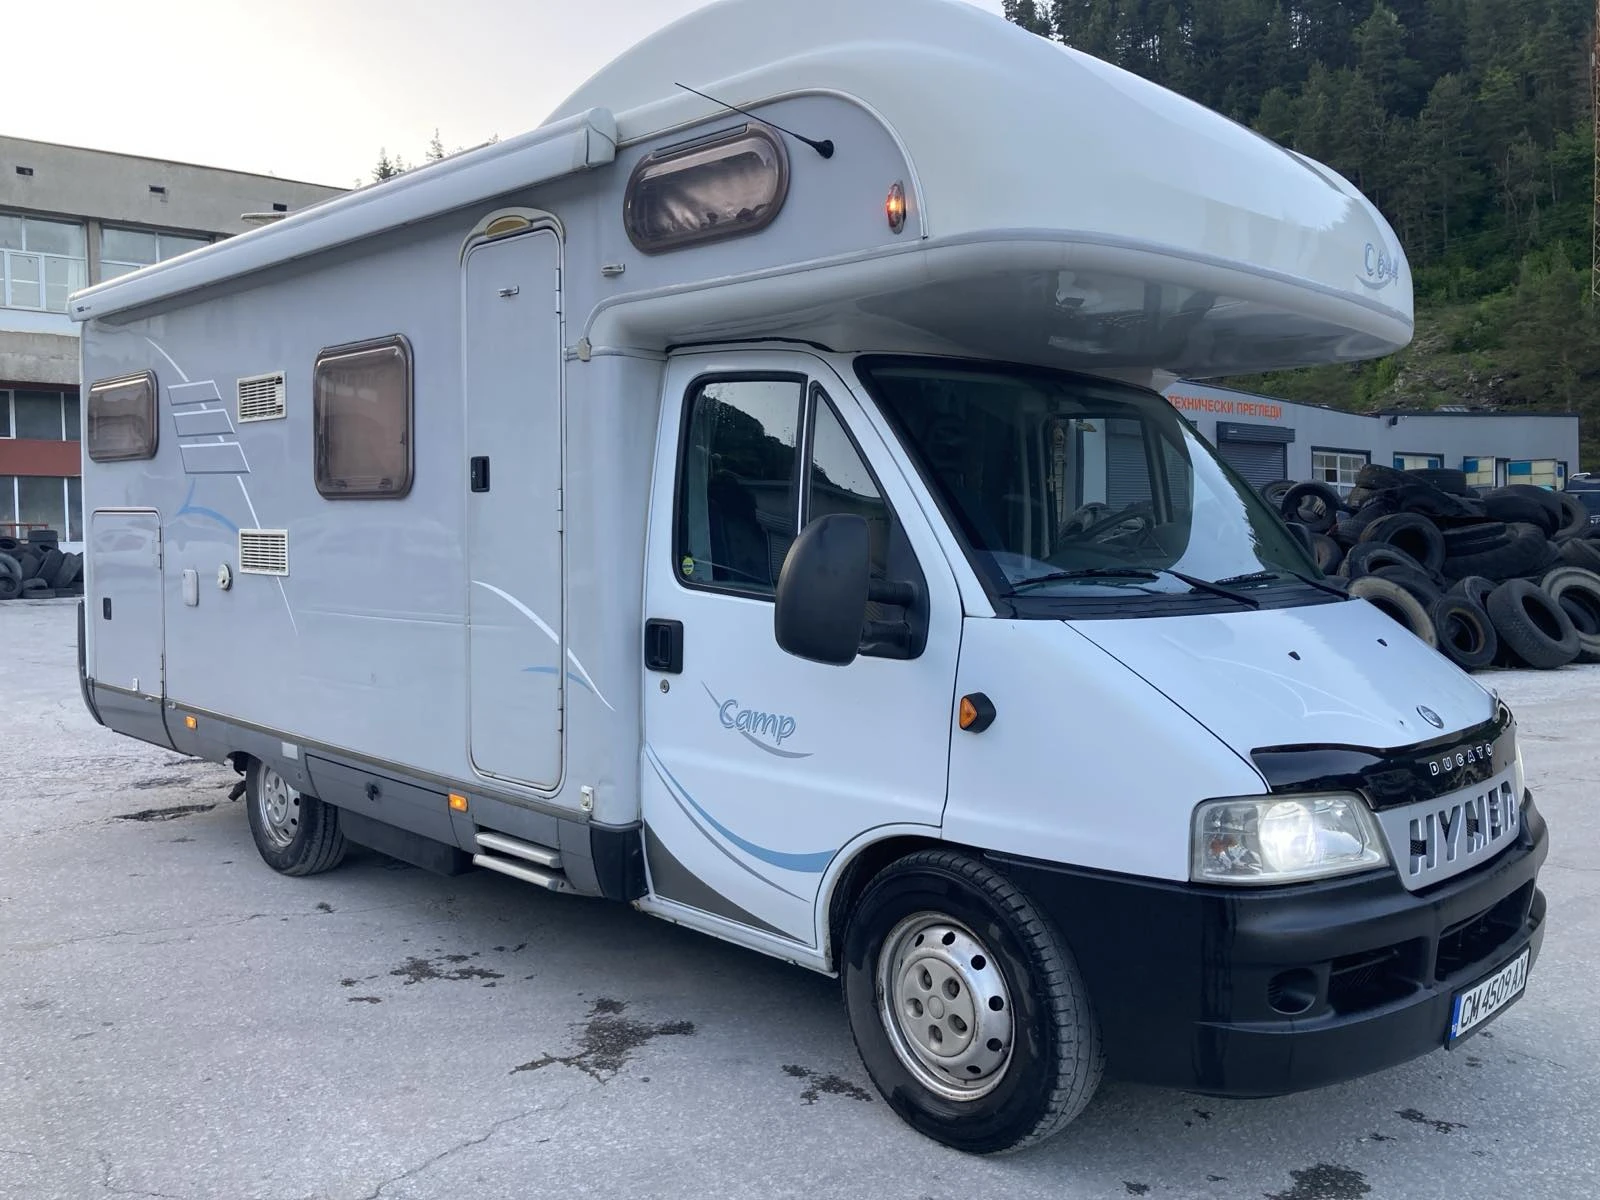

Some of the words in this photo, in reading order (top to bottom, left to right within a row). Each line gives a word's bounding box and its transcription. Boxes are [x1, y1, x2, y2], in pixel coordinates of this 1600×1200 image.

[1168, 394, 1233, 414] ТЕХНИЧЕСКИ
[1237, 402, 1282, 419] ПРЕГЛЕДИ
[719, 699, 796, 745] Camp
[1429, 743, 1493, 776] DUCATO
[1409, 781, 1517, 876] HYMER
